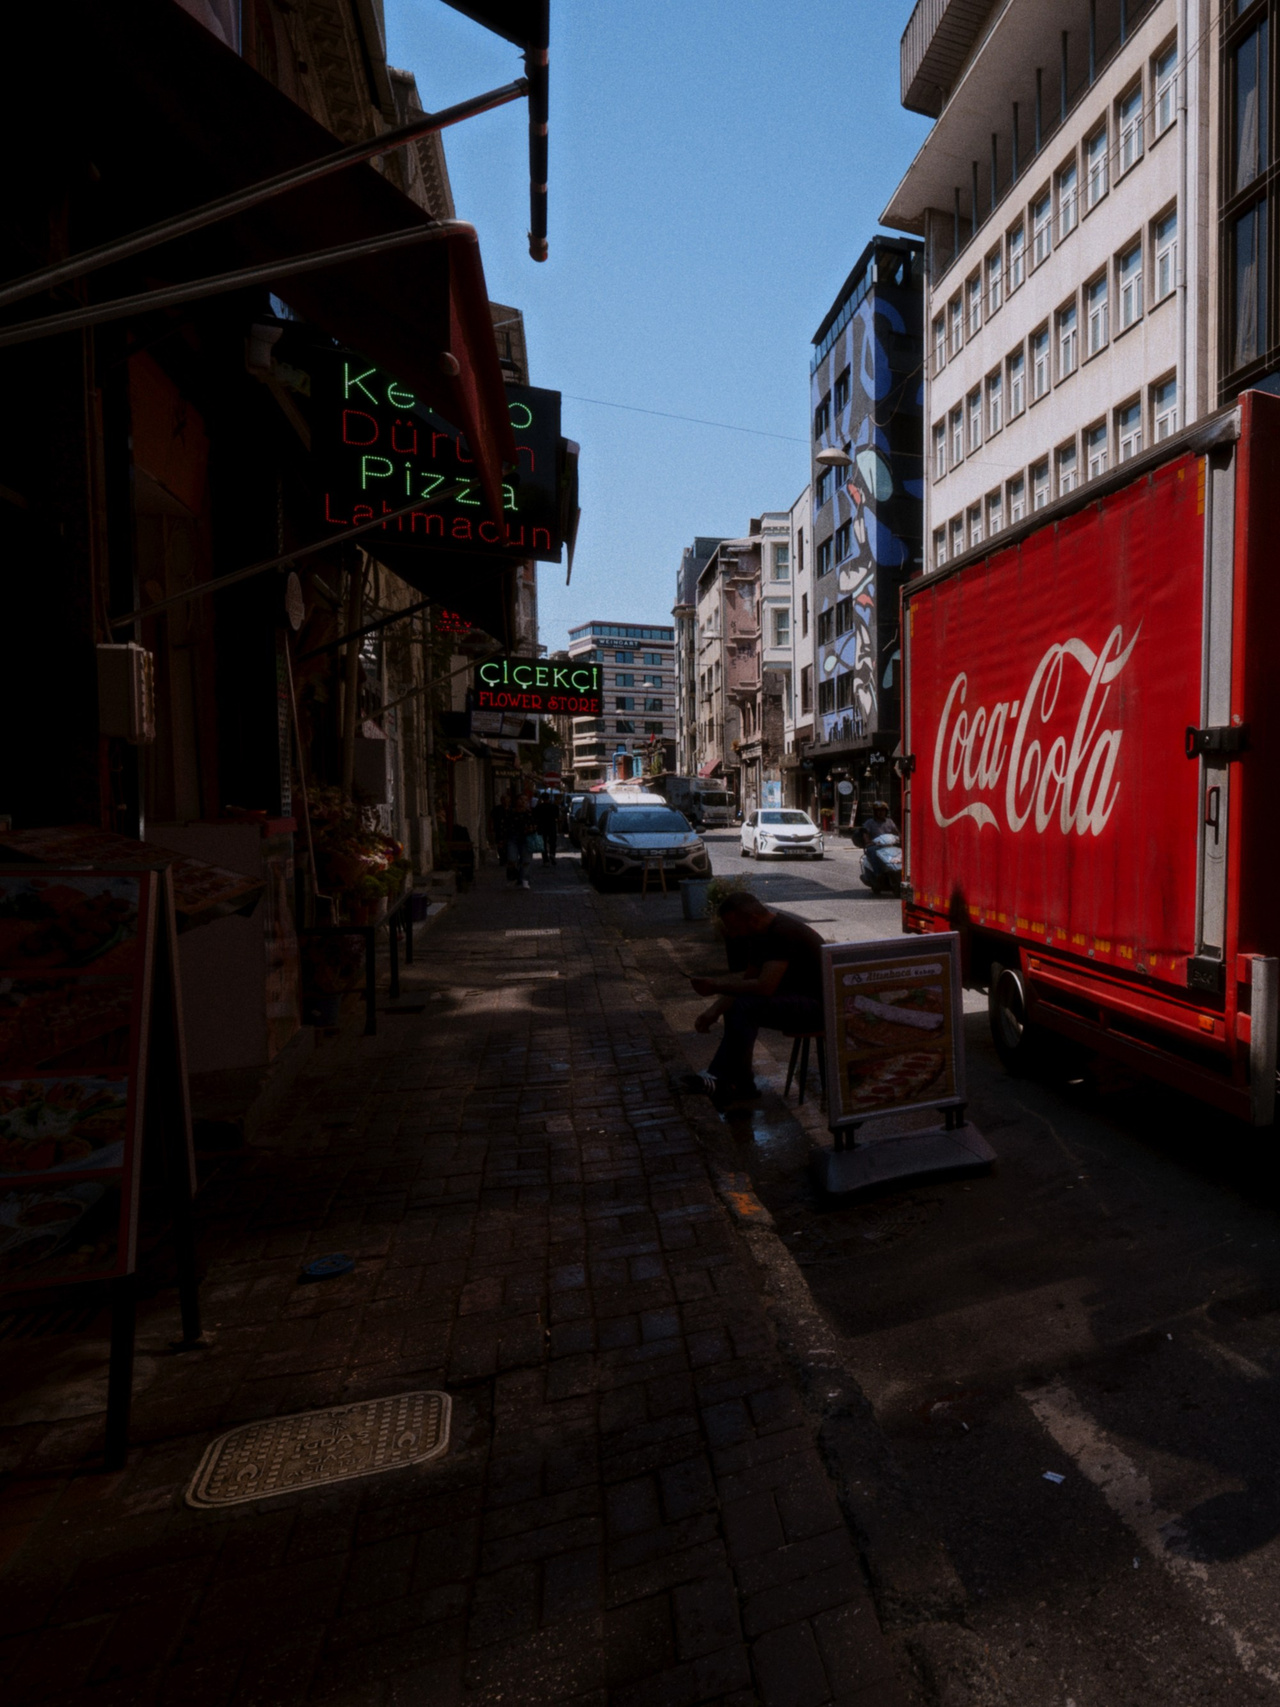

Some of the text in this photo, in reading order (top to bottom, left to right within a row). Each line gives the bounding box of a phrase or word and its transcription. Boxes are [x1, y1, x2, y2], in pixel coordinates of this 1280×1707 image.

[361, 454, 520, 514] Pizza
[324, 492, 551, 551] Lahmacun
[478, 690, 599, 714] FLOWER STORE
[479, 659, 598, 693] ÇİÇEKÇİ
[932, 615, 1144, 838] Coca-Cola
